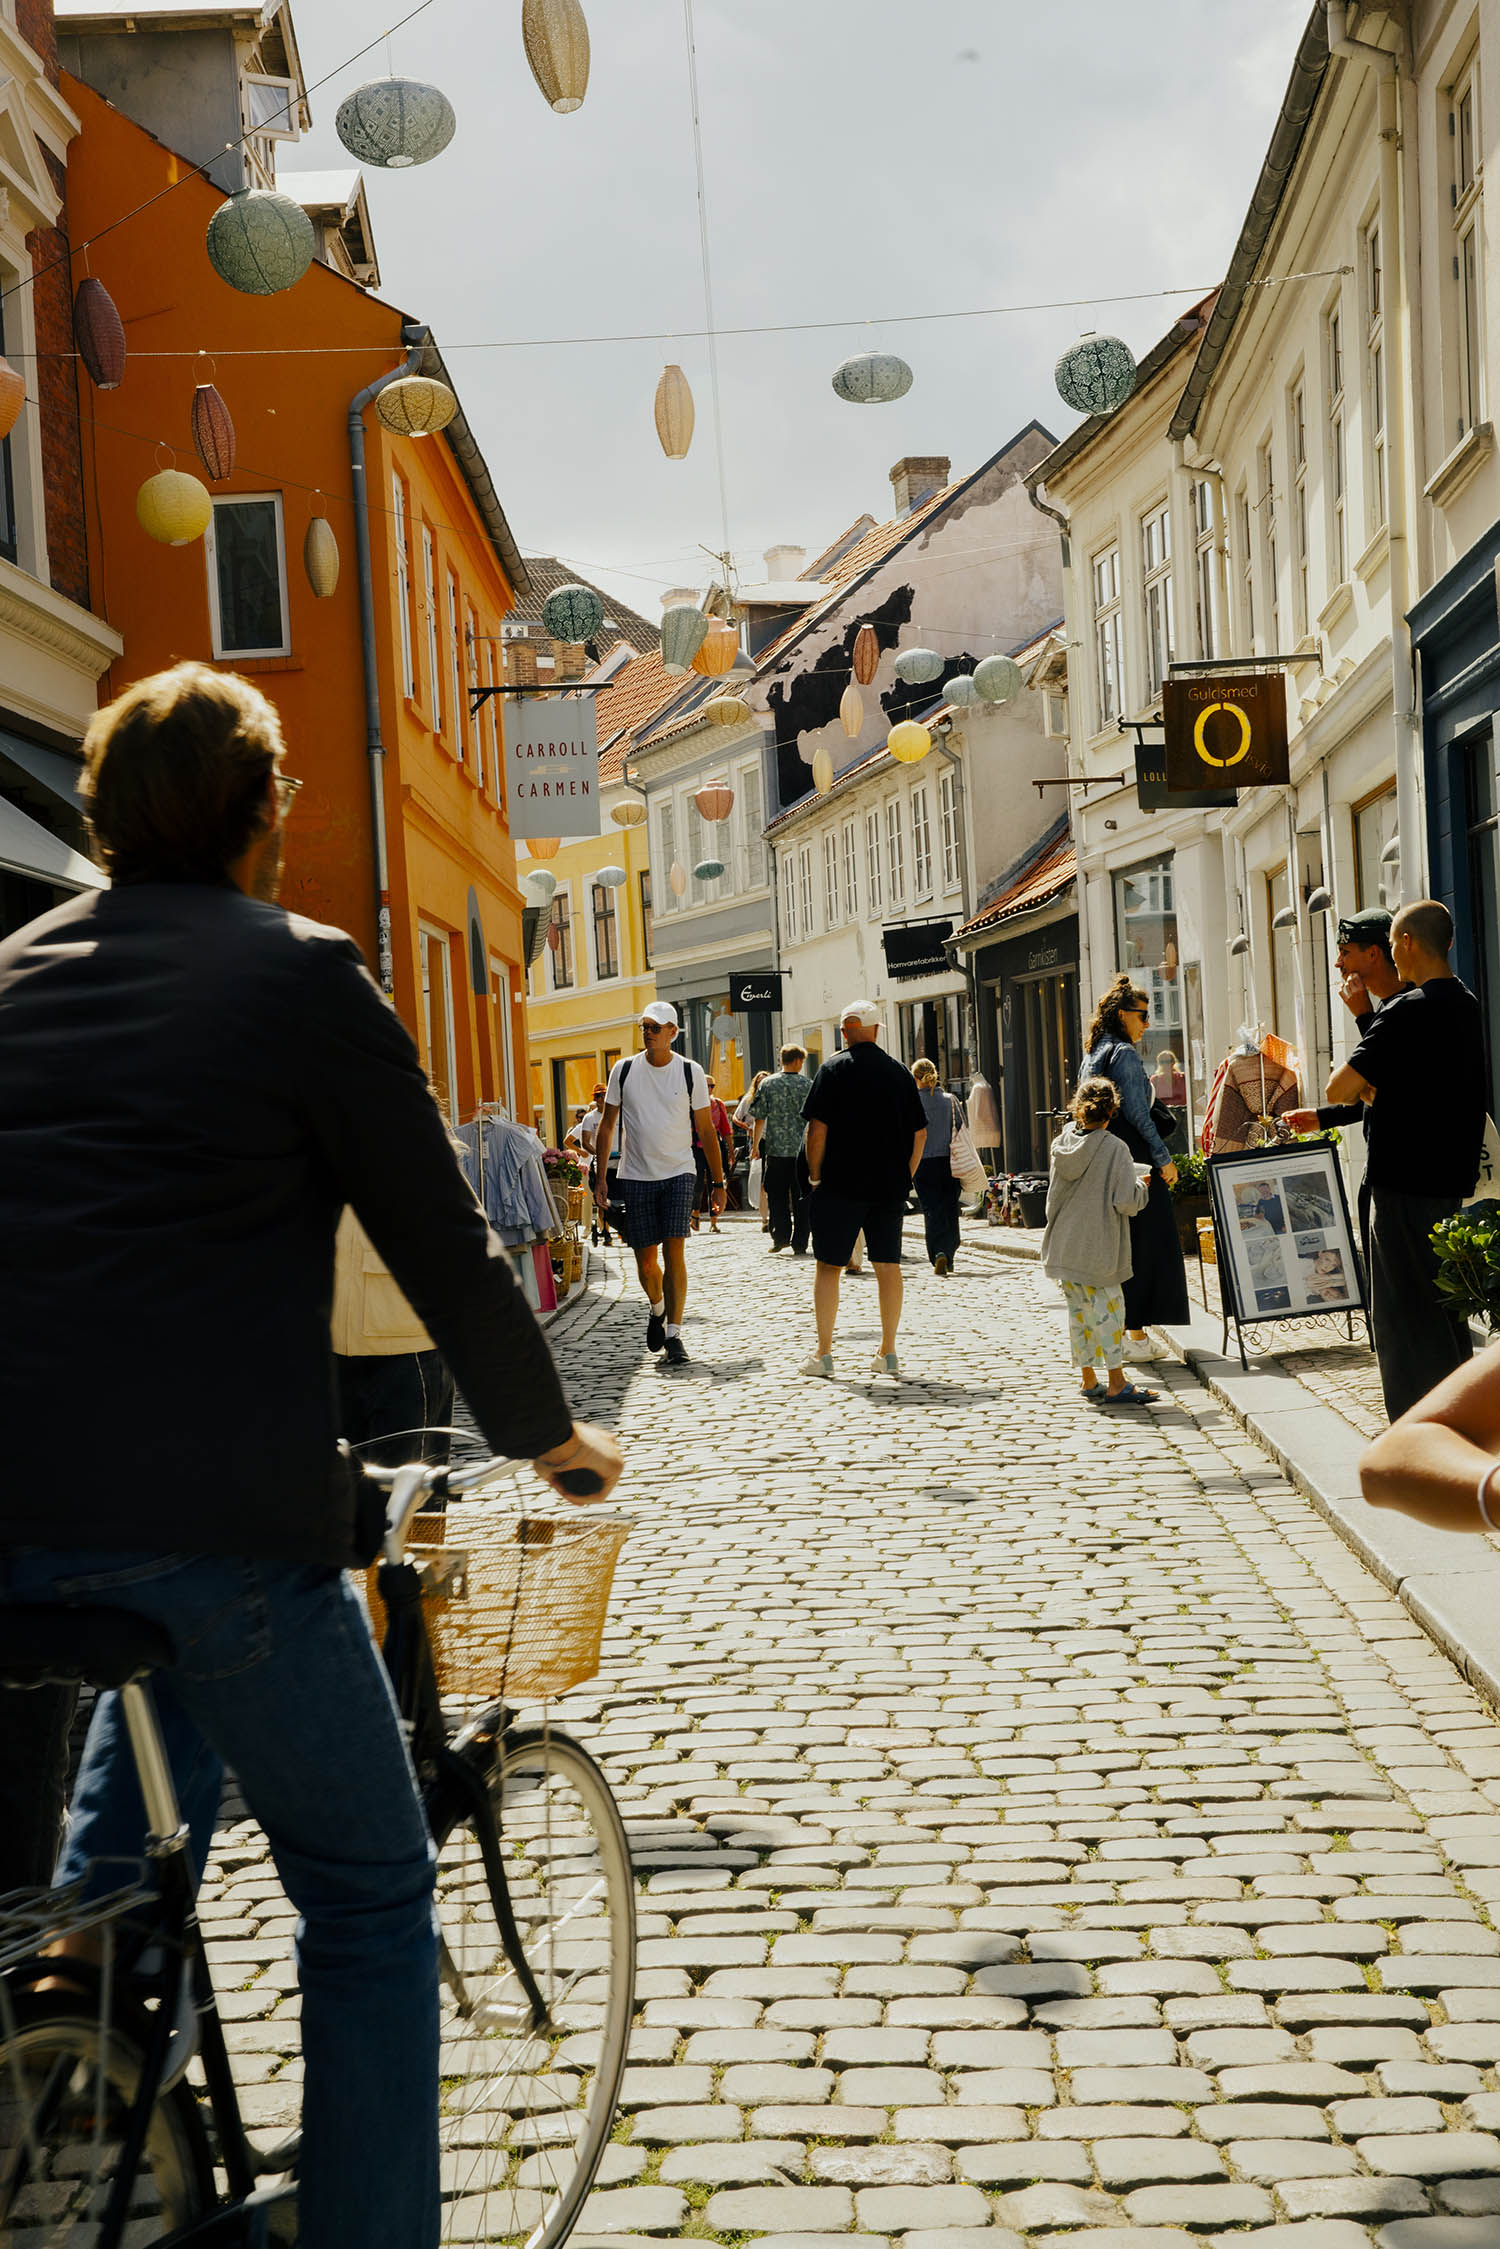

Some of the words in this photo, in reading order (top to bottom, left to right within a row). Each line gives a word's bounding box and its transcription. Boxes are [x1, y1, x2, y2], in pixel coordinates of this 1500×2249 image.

[1188, 684, 1258, 702] Guldsmed
[515, 741, 588, 759] CARROLL
[517, 780, 590, 798] CARMEN
